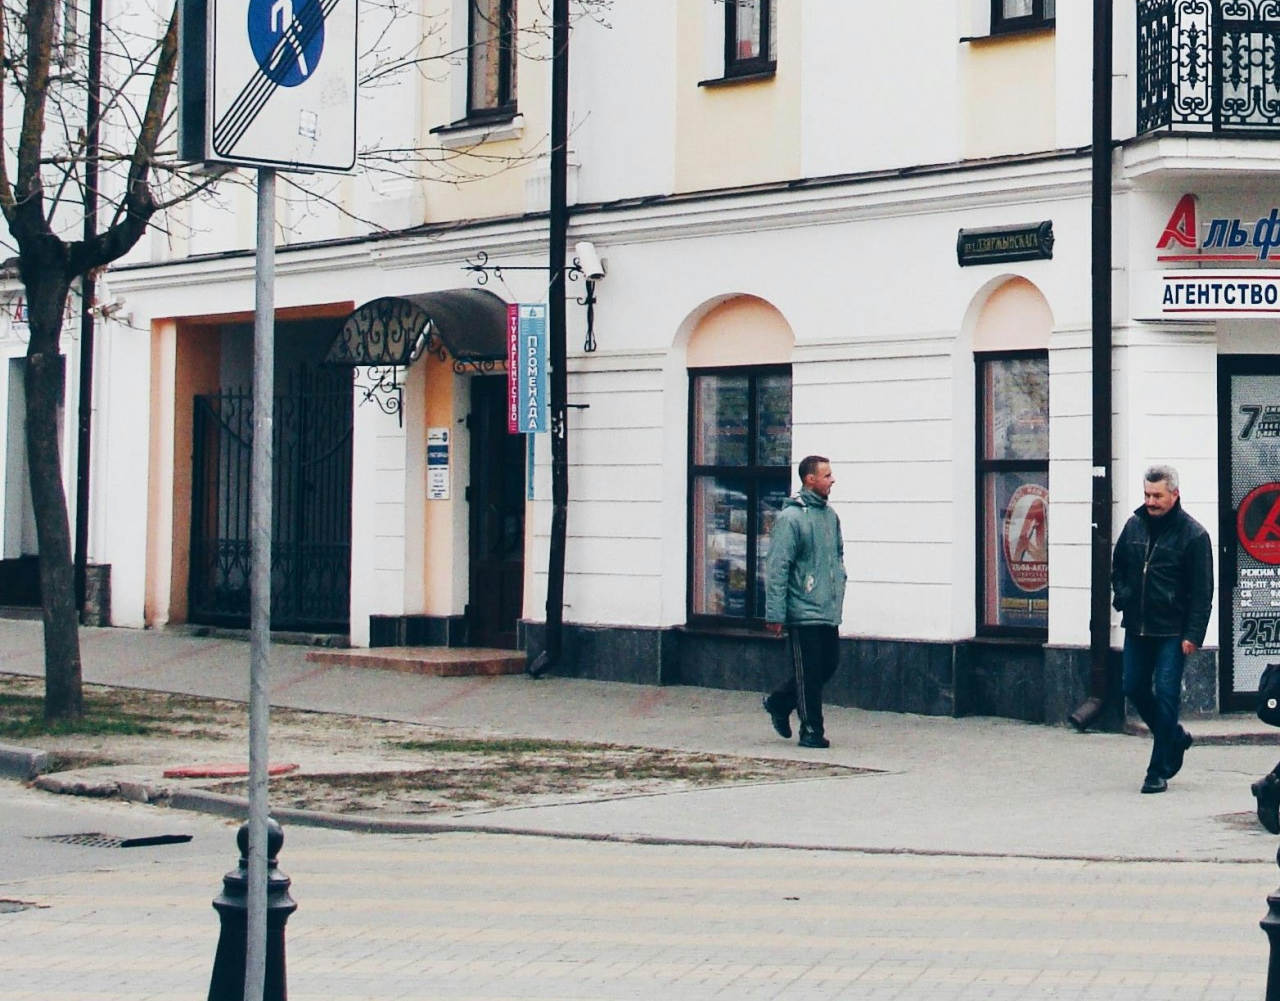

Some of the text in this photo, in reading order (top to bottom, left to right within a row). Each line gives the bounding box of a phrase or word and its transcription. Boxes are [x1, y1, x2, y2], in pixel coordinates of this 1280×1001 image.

[1163, 283, 1279, 306] АГЕНТСТВО
[527, 335, 538, 430] ПРОМЕНАДА
[1238, 405, 1262, 440] 7
